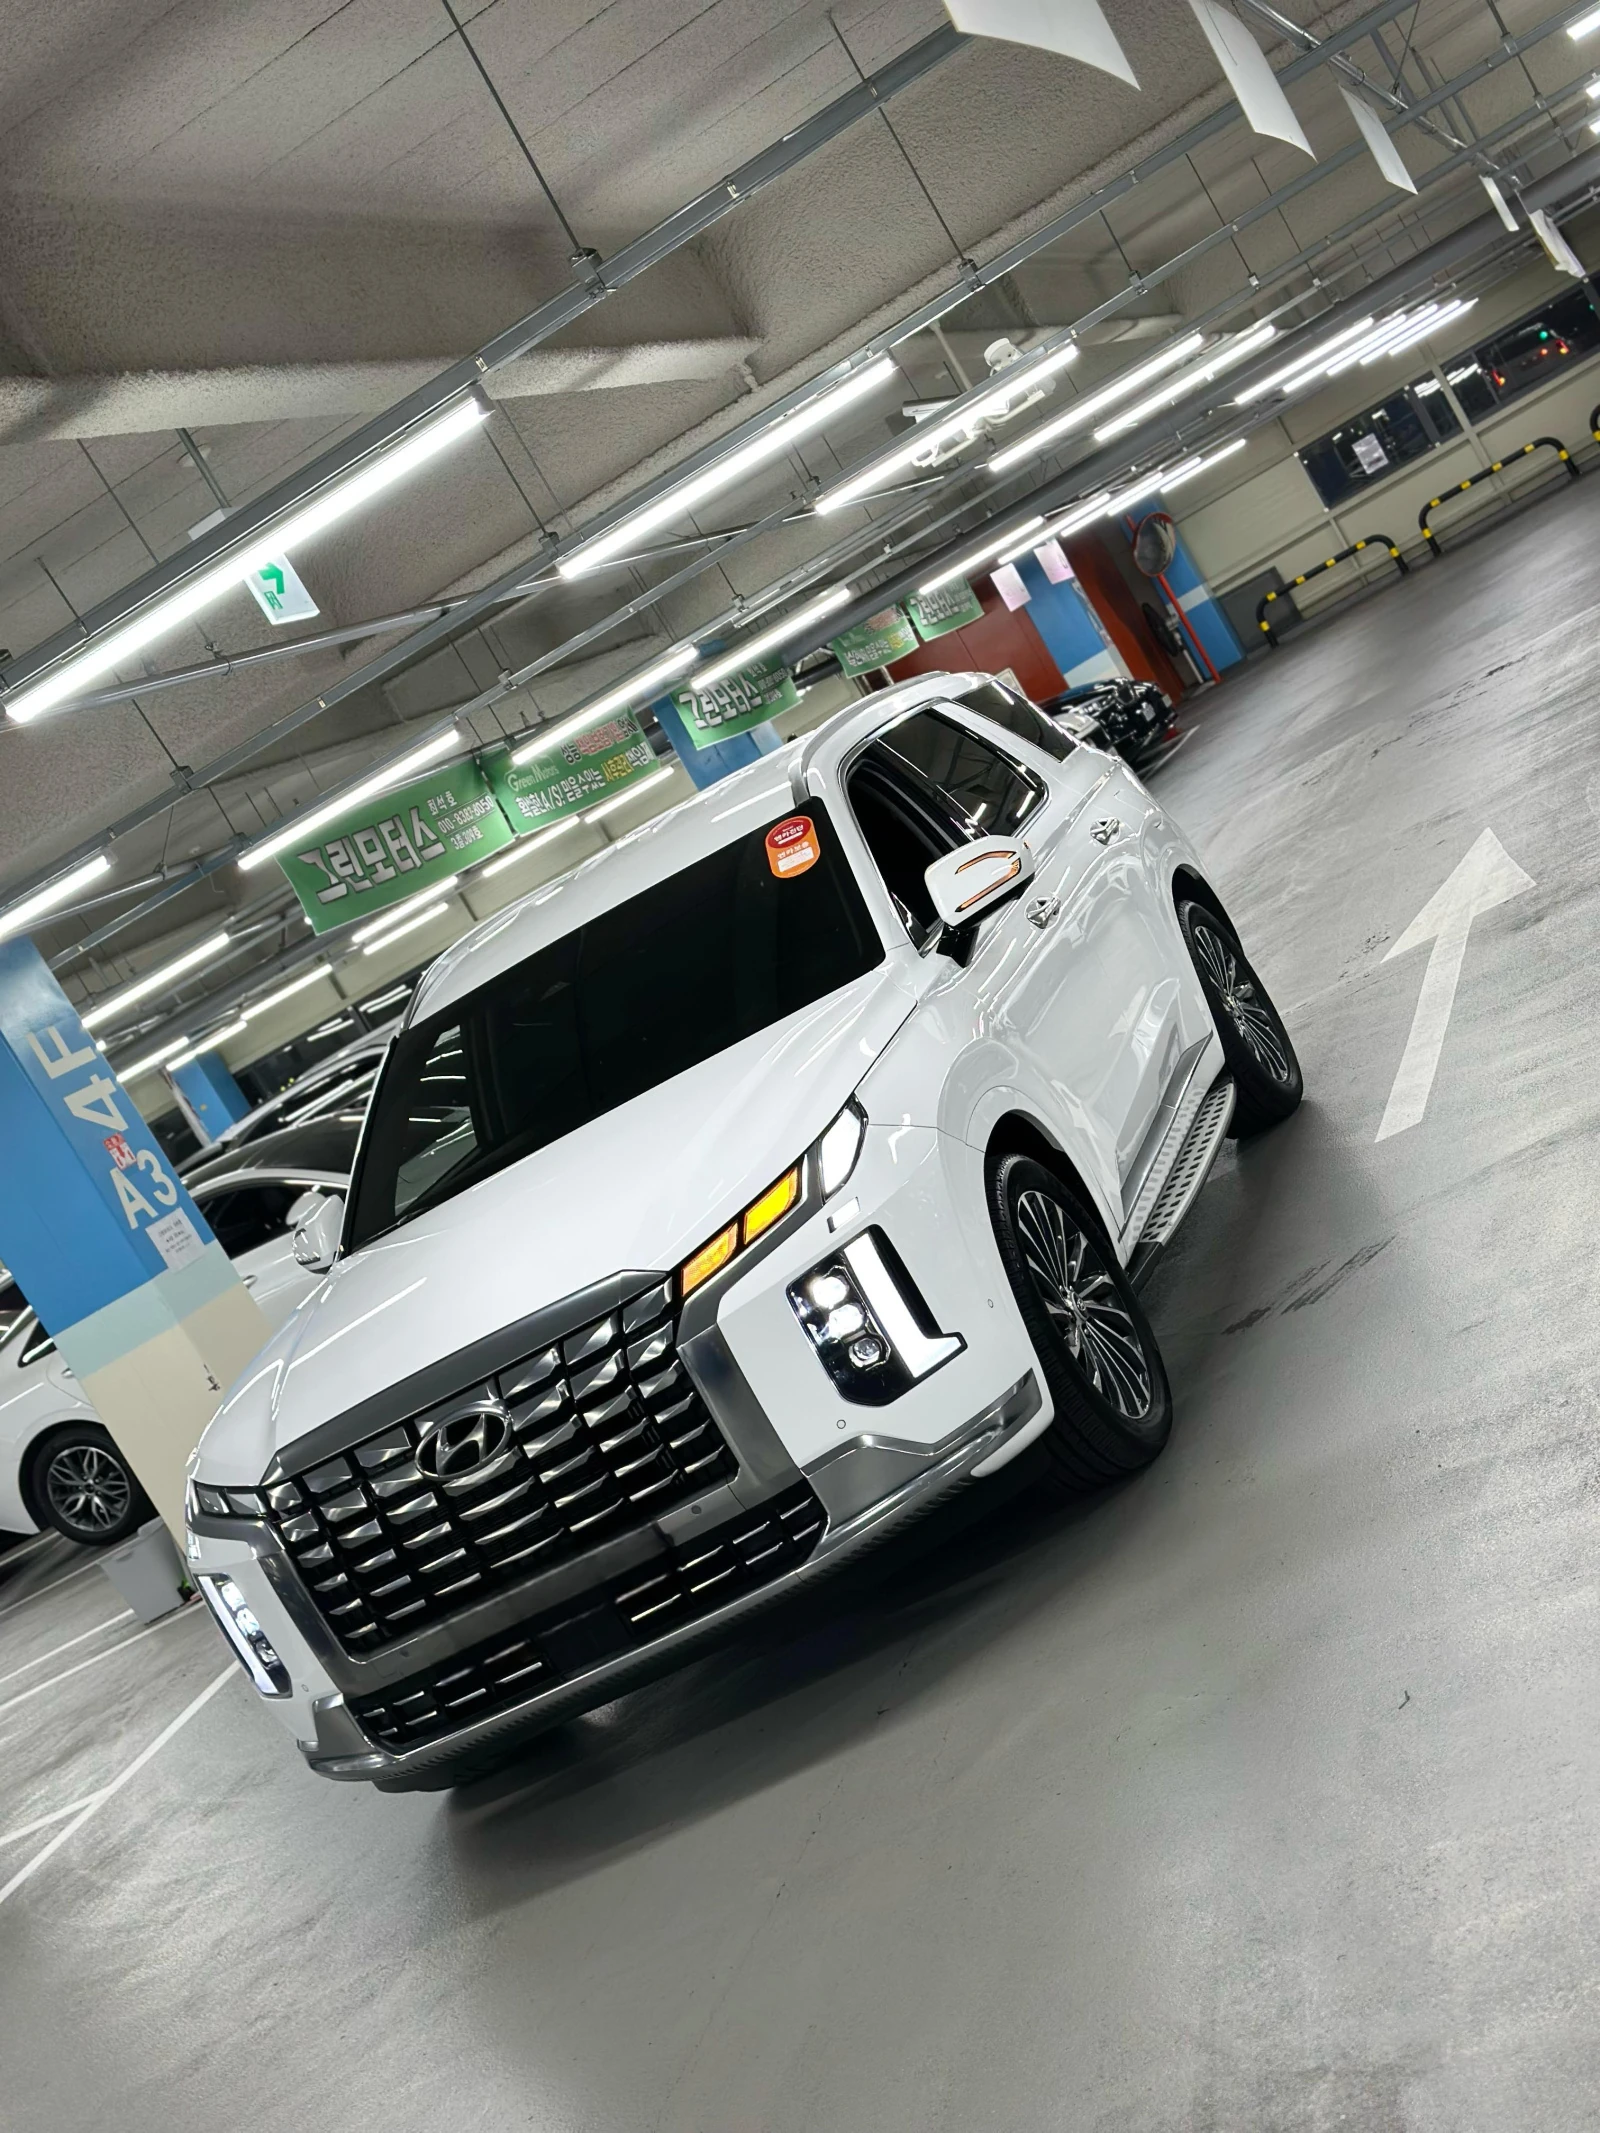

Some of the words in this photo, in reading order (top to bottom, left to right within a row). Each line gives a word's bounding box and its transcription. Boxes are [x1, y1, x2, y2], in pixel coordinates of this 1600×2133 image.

[679, 671, 762, 729] 그린모터스
[297, 805, 447, 905] 그린모터스
[26, 1026, 129, 1131] 4F
[109, 1149, 178, 1229] A3
